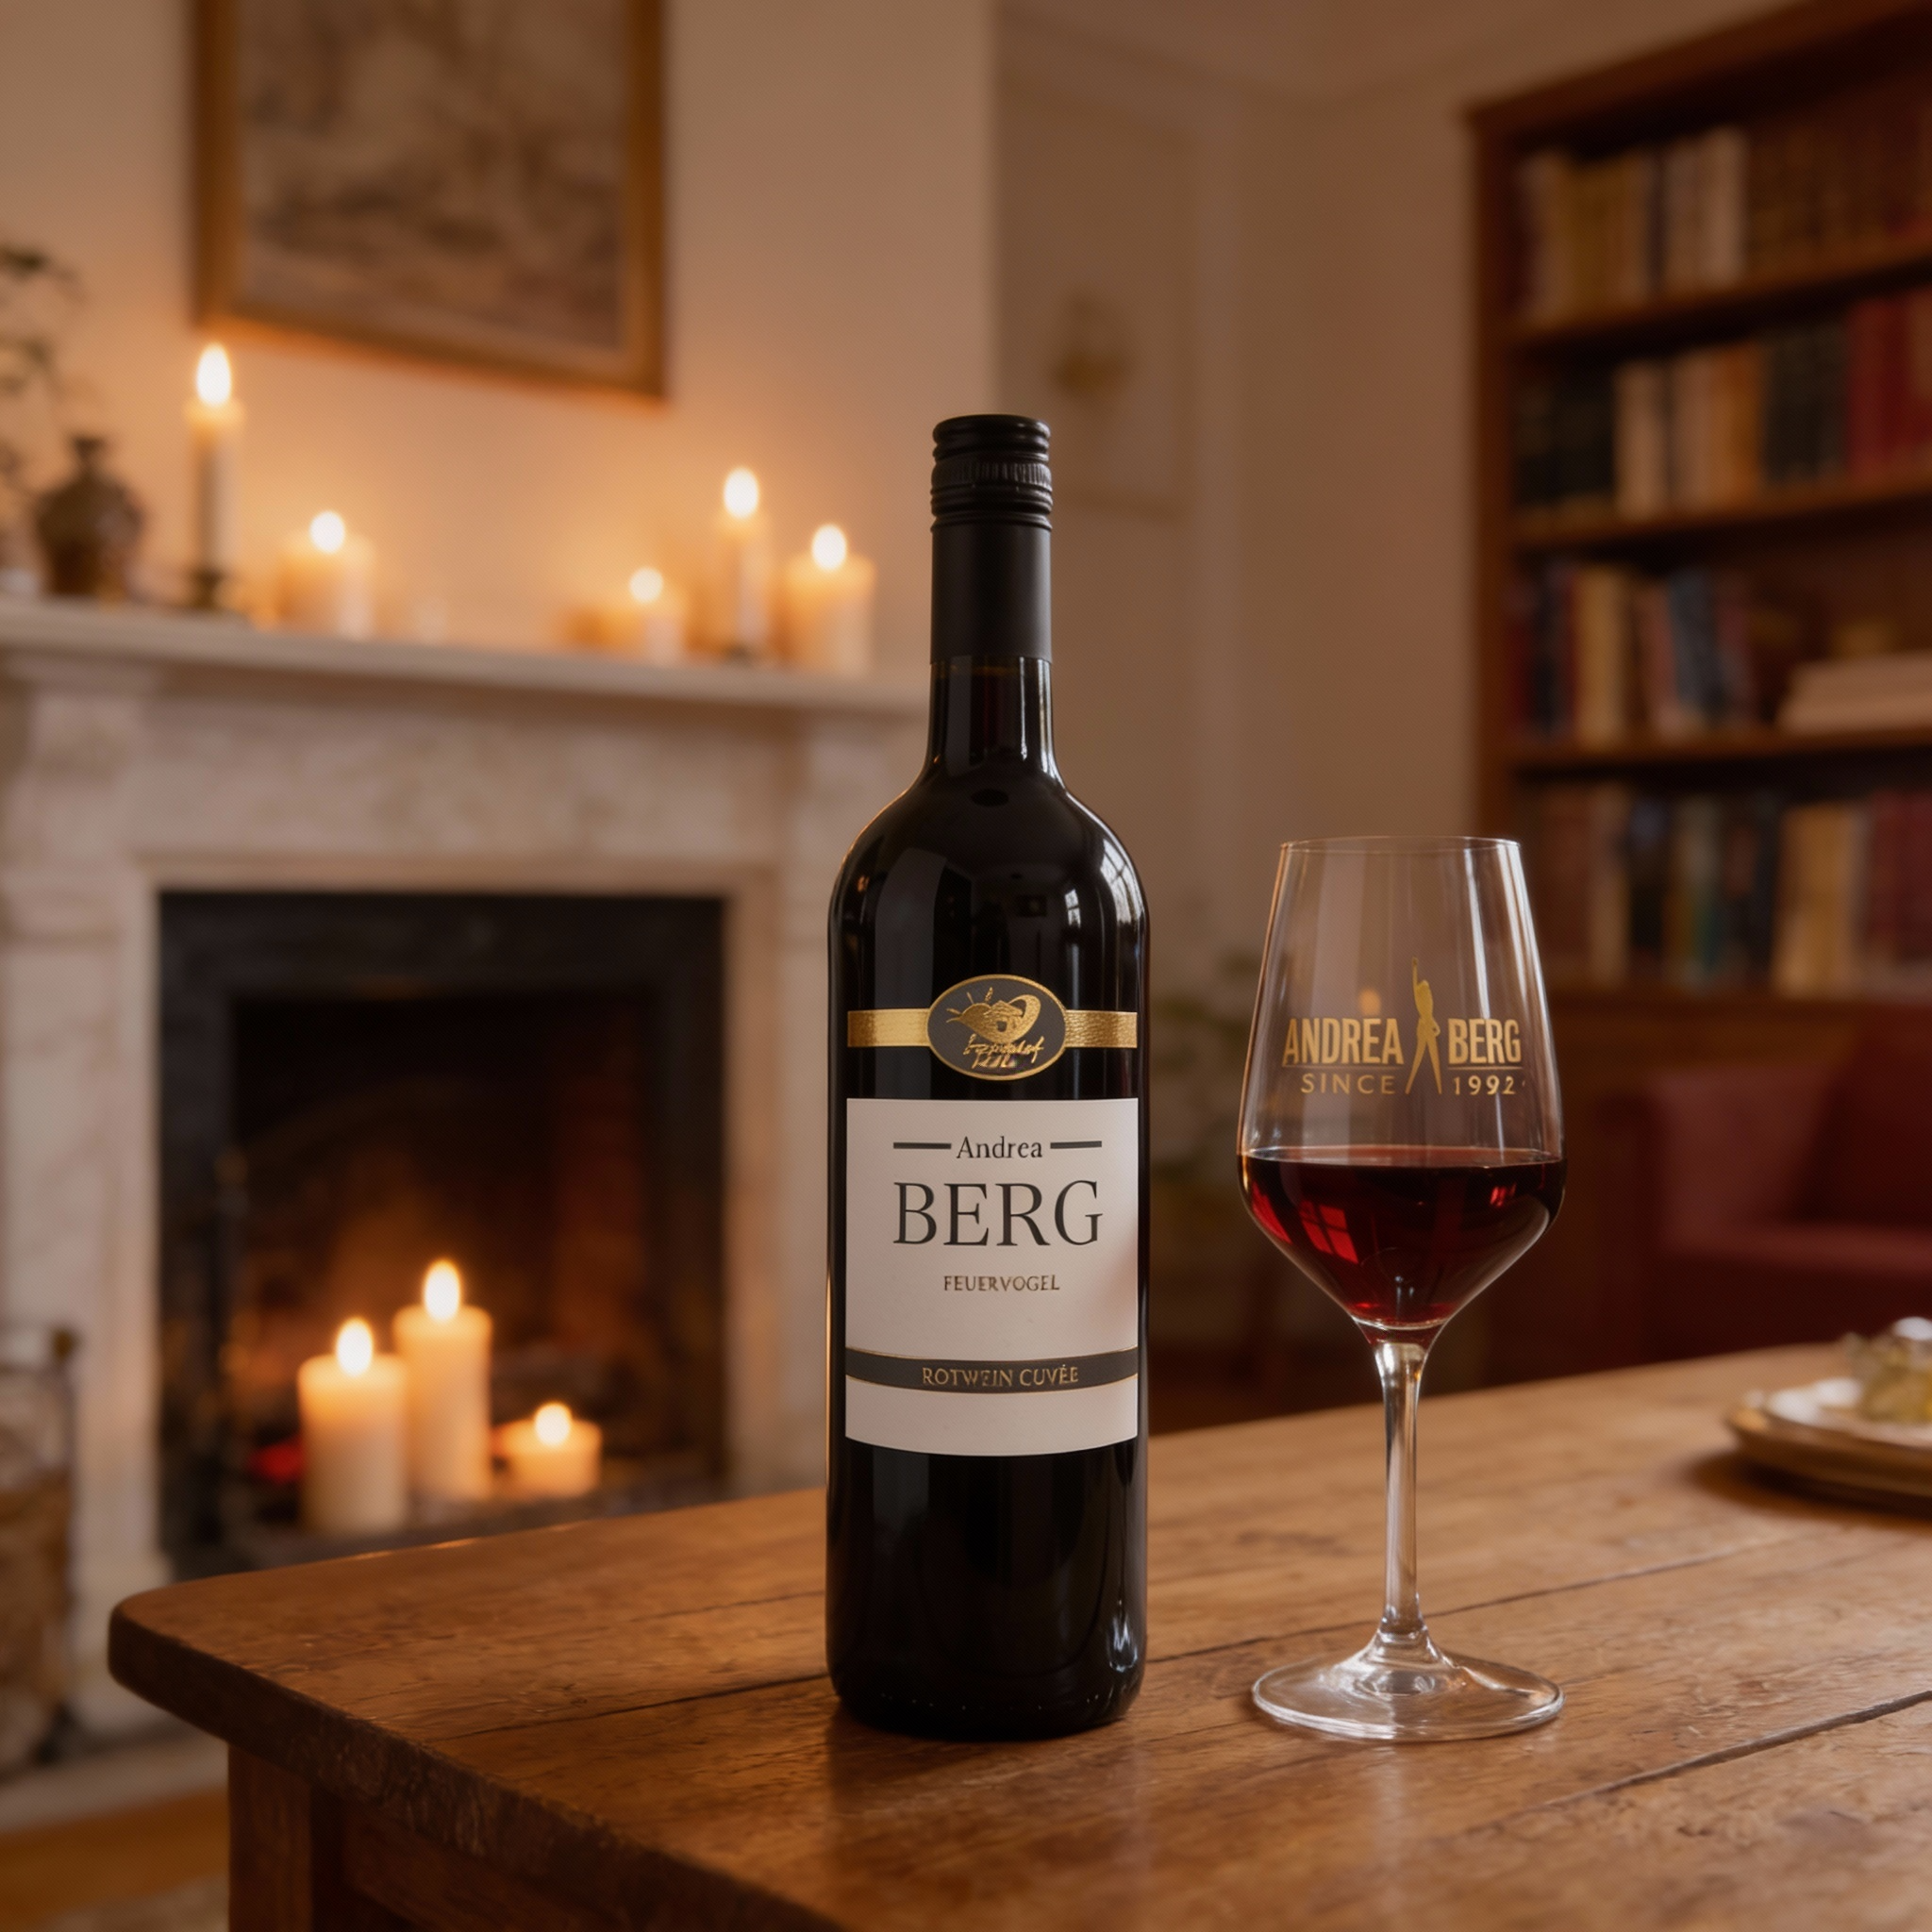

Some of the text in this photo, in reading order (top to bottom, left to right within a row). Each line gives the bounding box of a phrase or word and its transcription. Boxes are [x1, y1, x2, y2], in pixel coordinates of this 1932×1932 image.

[1283, 1018, 1522, 1064] ANDREA BERG
[1300, 1073, 1516, 1096] SINCE 1992
[956, 1135, 1043, 1159] Andrea
[892, 1179, 1104, 1246] BERG
[943, 1274, 1060, 1292] FEUERVOGEL
